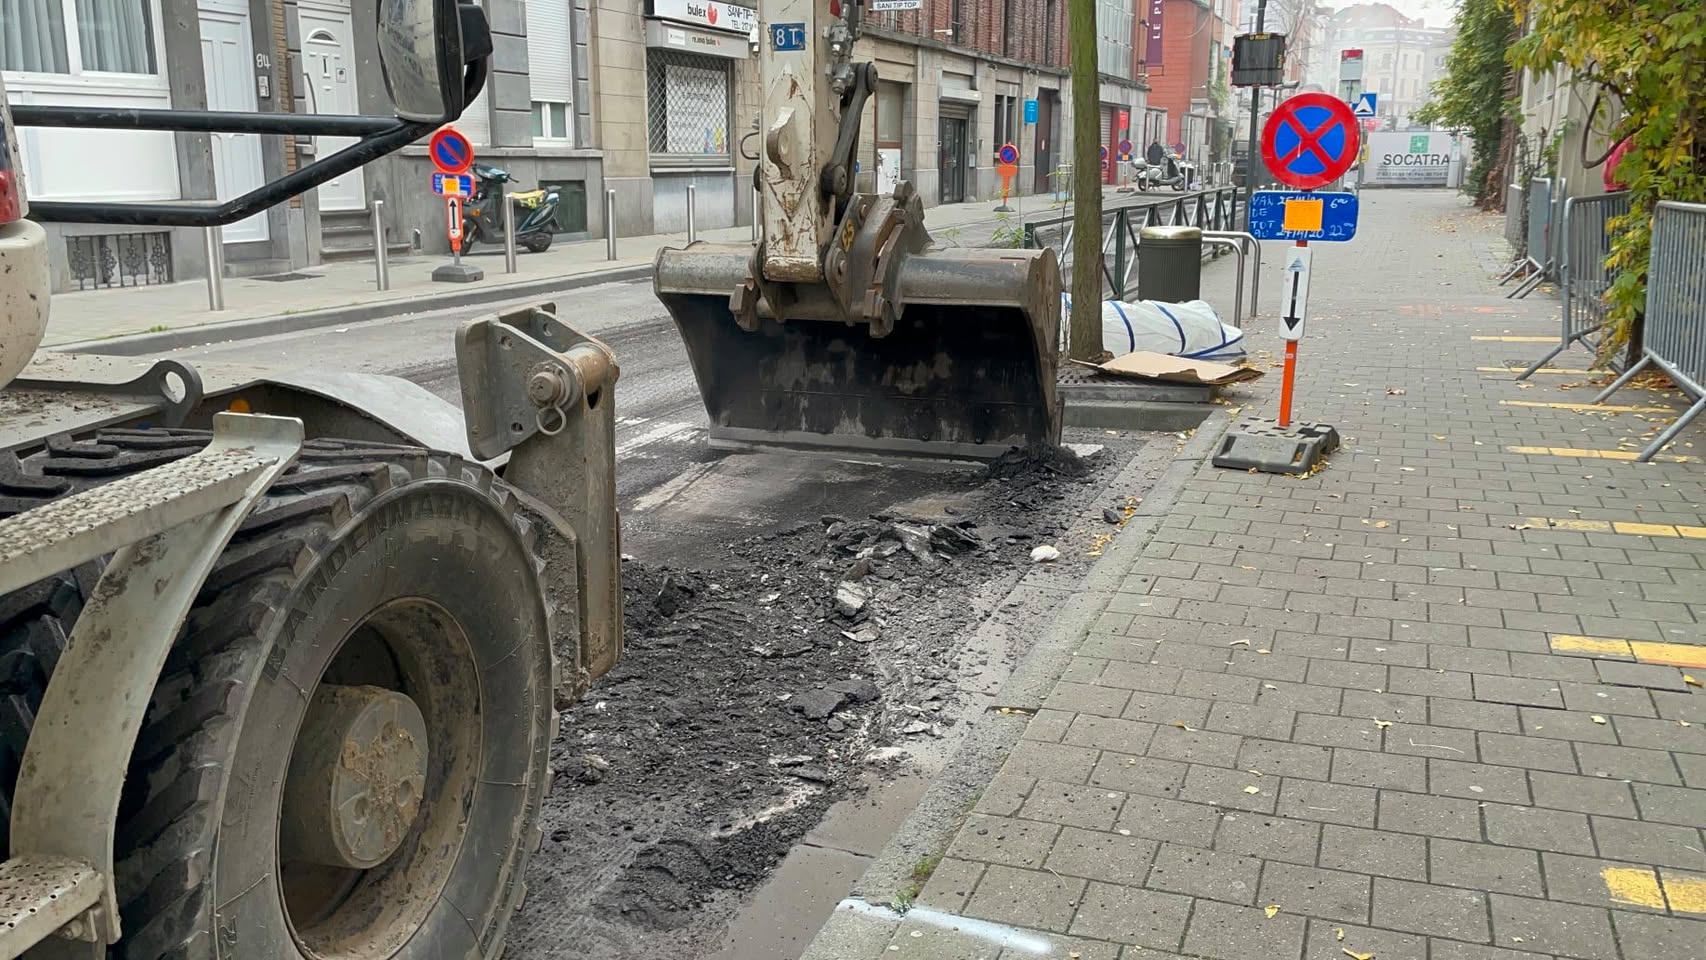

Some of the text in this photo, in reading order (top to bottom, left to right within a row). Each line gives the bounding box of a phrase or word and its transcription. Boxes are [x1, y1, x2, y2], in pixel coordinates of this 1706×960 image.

[687, 3, 706, 18] bulex
[776, 28, 798, 46] 8 T
[1153, 23, 1161, 39] LE
[256, 53, 271, 69] 84
[1383, 154, 1450, 166] SOCATRA
